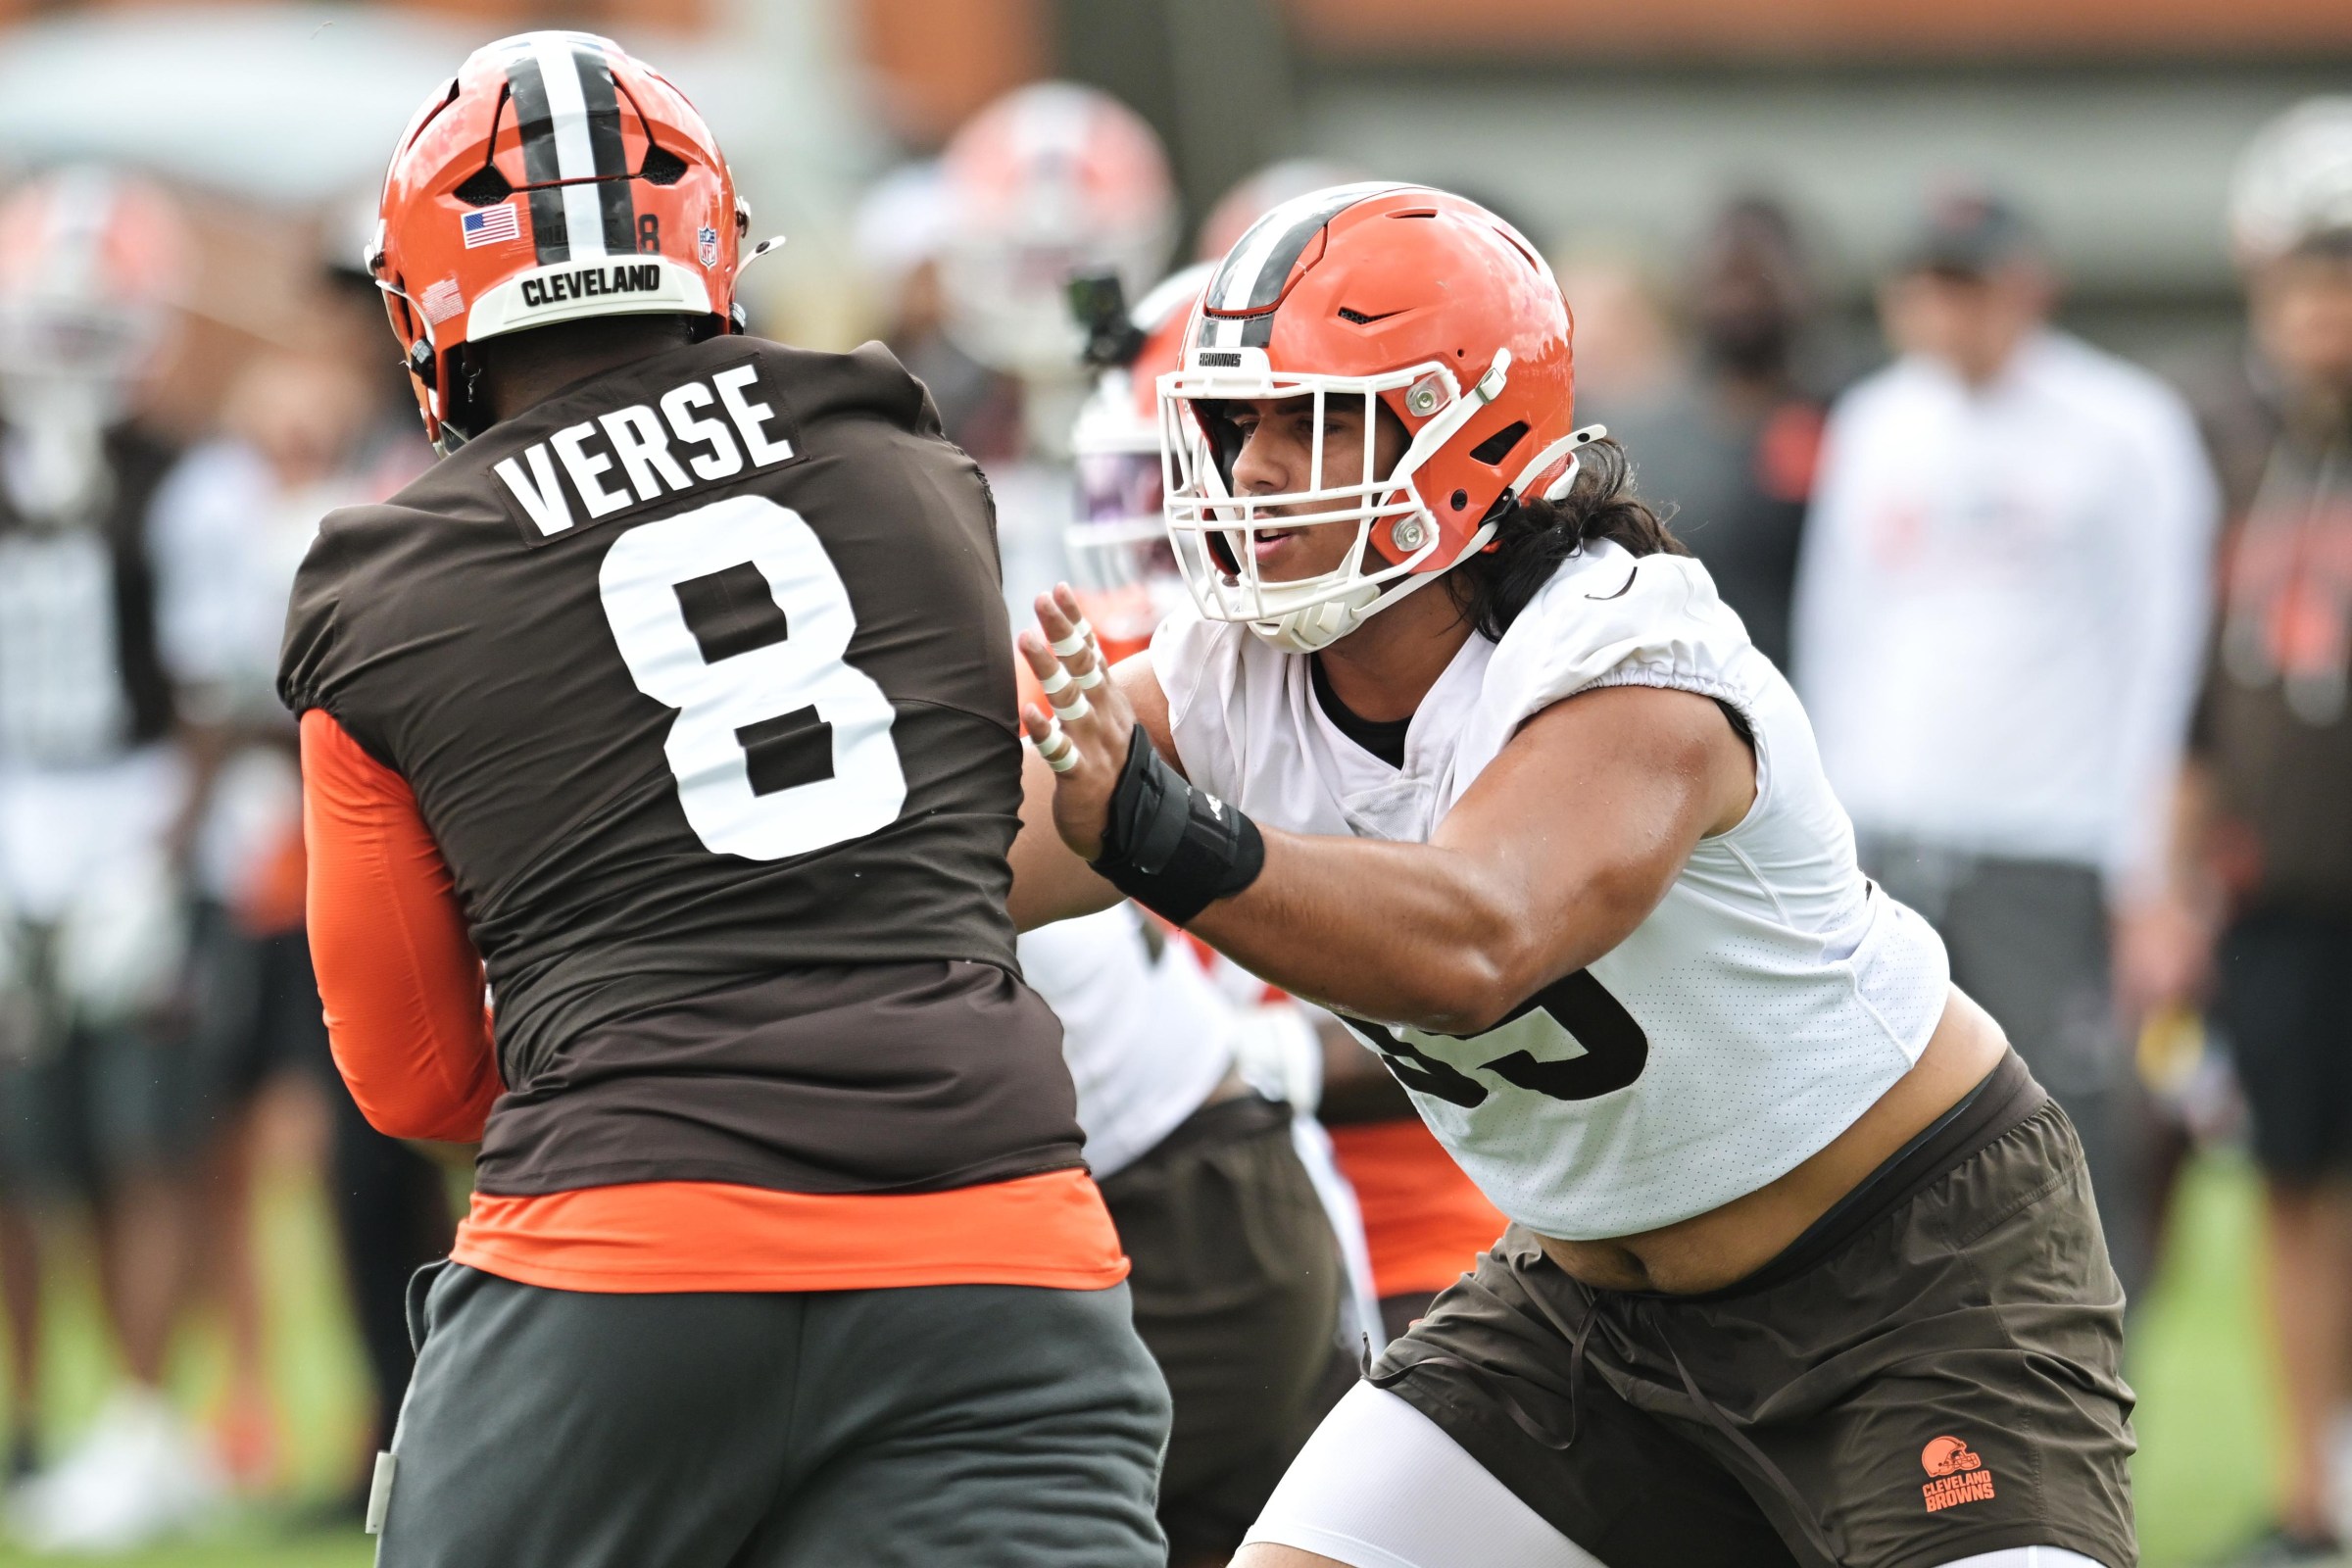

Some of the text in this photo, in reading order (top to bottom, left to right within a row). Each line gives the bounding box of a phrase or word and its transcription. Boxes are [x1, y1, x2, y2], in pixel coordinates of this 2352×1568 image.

[638, 214, 661, 255] 8
[521, 265, 661, 307] CLEVELAND
[1199, 353, 1242, 368] BROWNS
[494, 364, 795, 537] VERSE
[599, 495, 908, 861] 8
[1922, 1470, 1992, 1497] CLEVELAND
[1926, 1483, 1995, 1513] BROWNS
